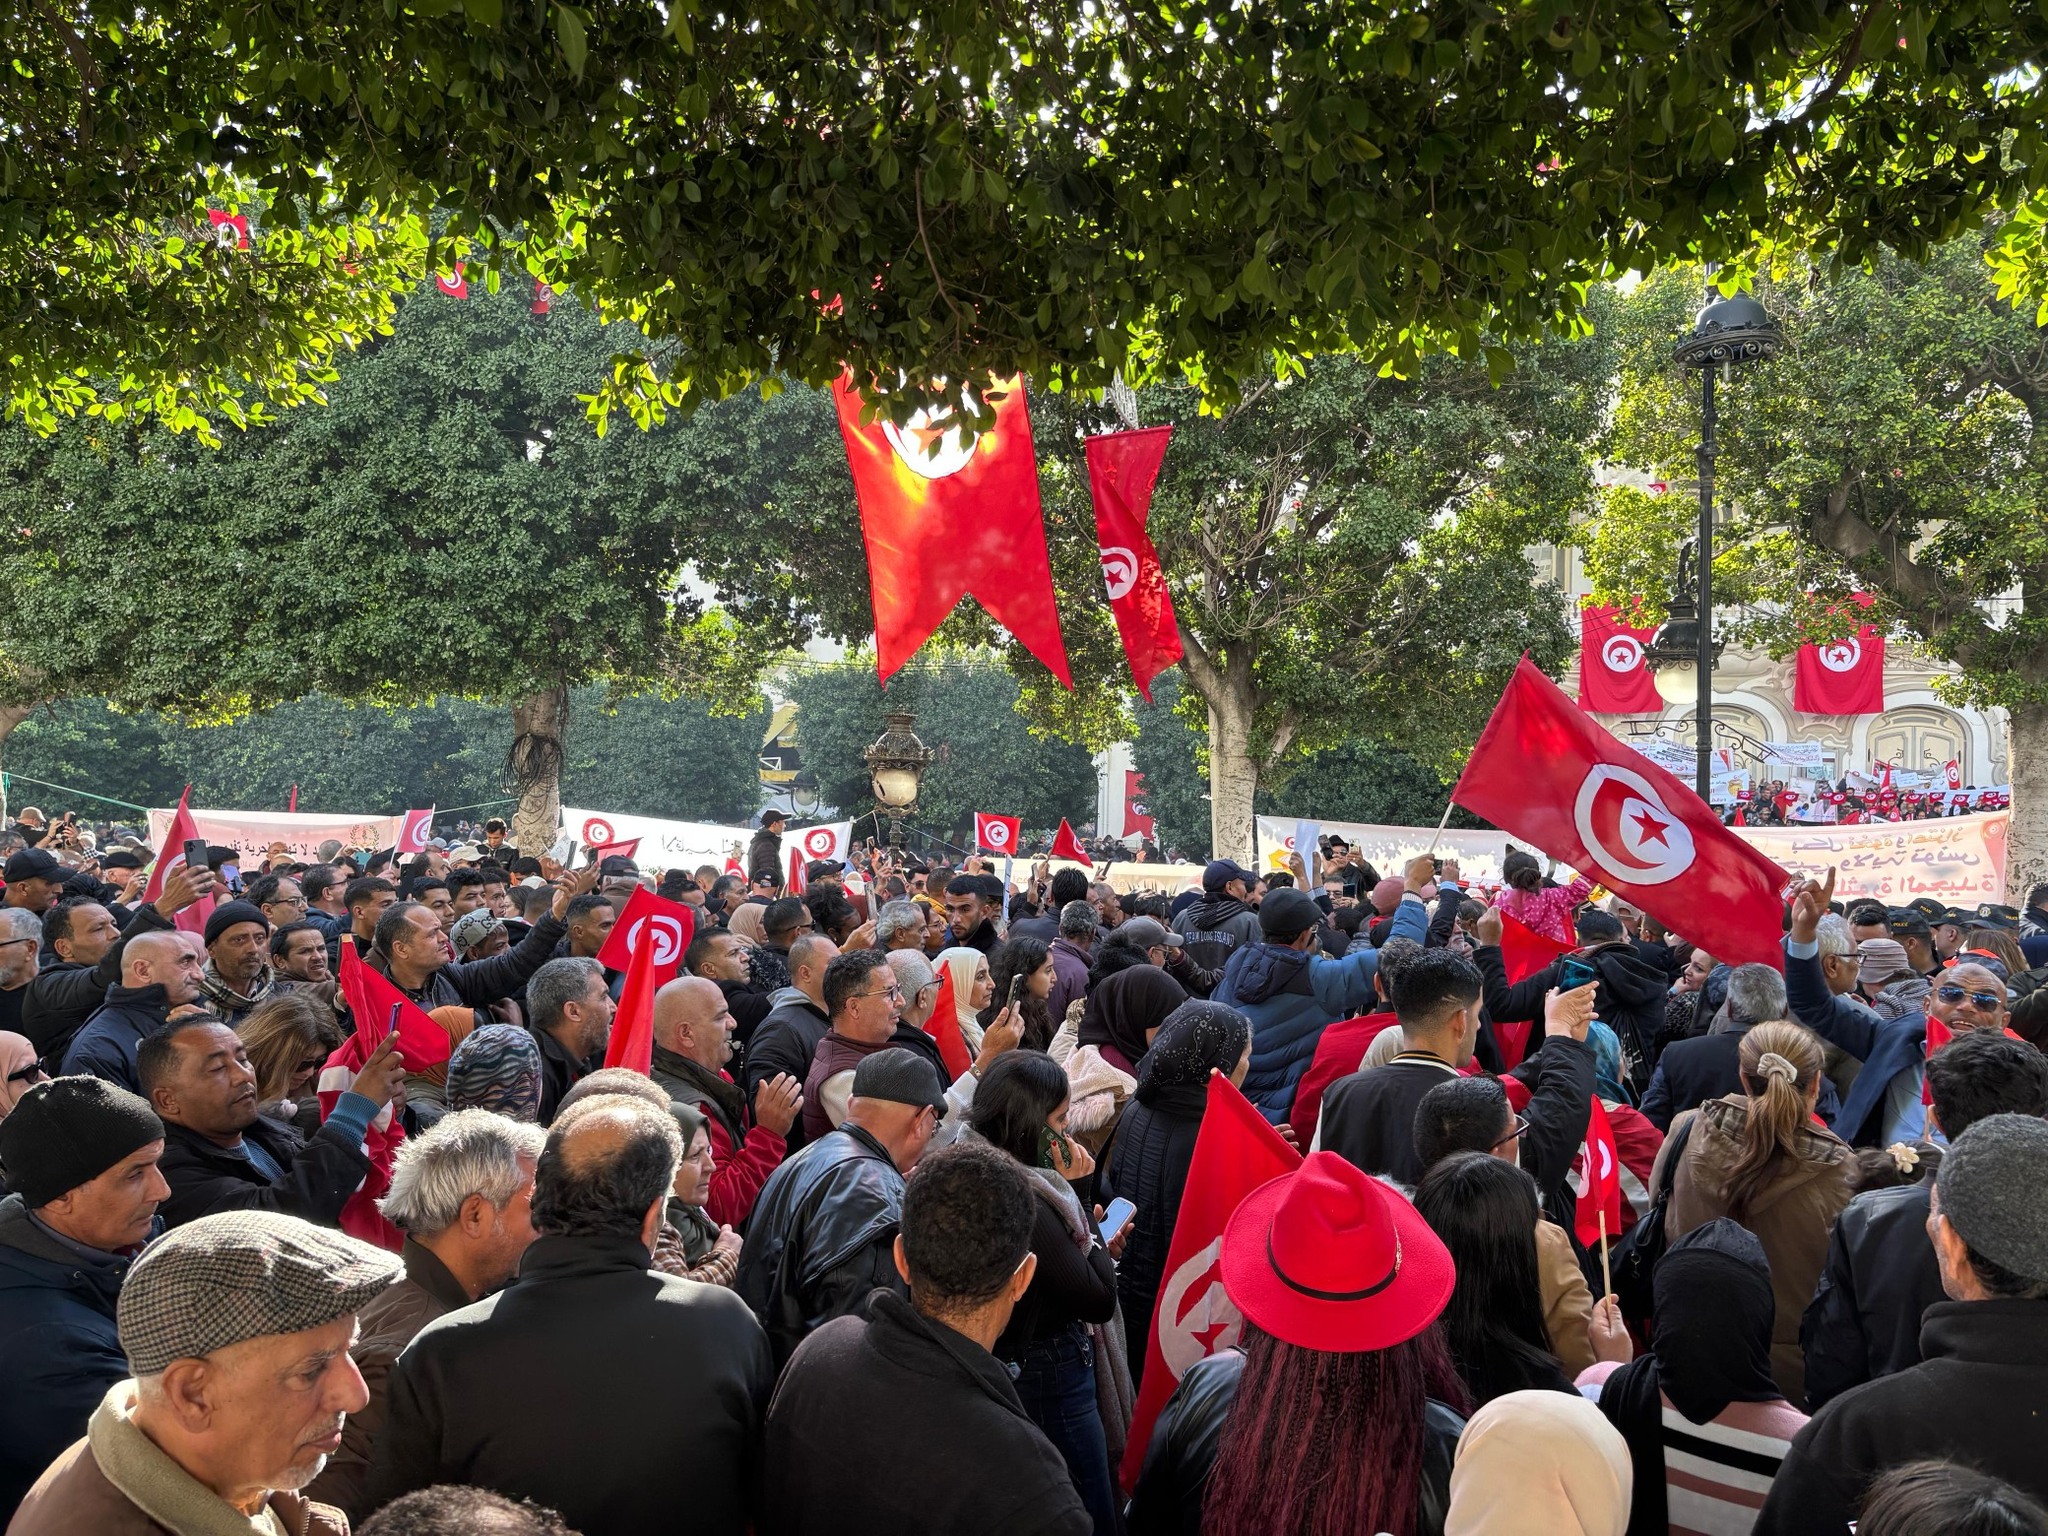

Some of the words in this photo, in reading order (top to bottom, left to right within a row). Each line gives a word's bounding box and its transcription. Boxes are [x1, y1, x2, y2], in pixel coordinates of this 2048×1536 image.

[1185, 931, 1200, 944] TEAM
[1200, 930, 1214, 942] LONG
[1214, 930, 1235, 948] ISLAND
